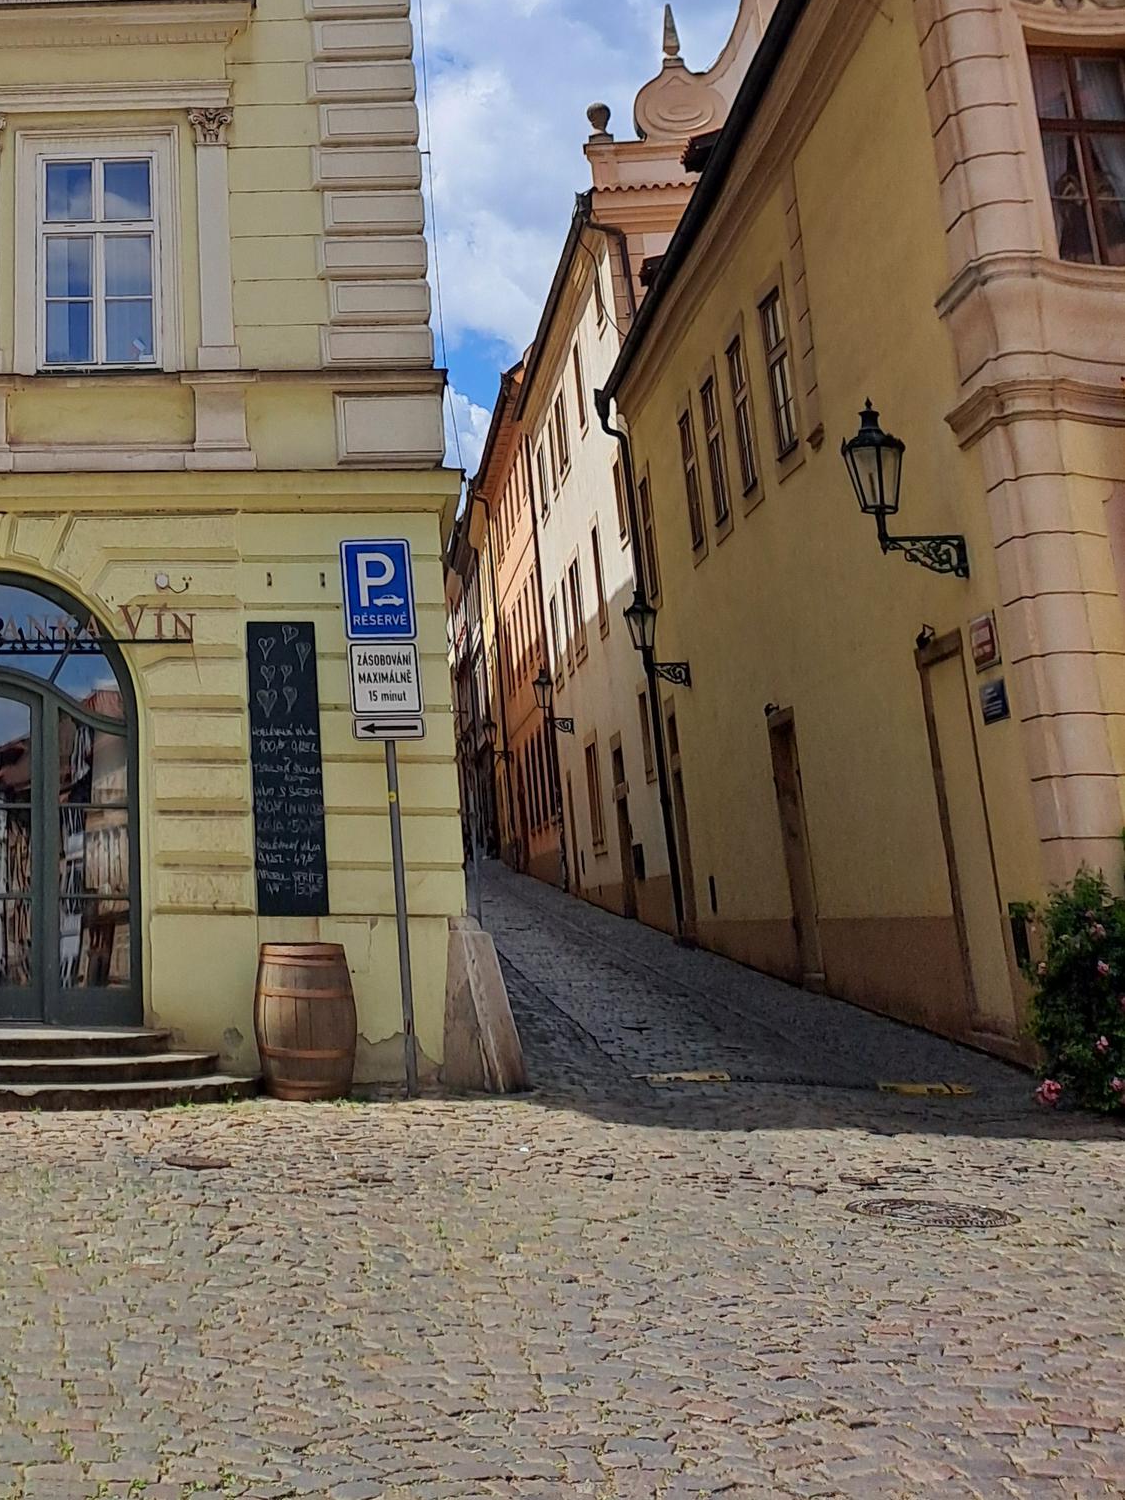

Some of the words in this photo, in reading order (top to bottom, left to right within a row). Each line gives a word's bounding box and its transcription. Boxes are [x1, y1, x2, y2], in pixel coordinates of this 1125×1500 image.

[356, 552, 395, 607] P
[118, 602, 196, 640] VÍN
[357, 653, 412, 667] ZÁSOBOVÁNÍ
[358, 670, 412, 684] MAXIMÁLNĚ
[368, 690, 378, 702] 15
[381, 691, 407, 702] minut
